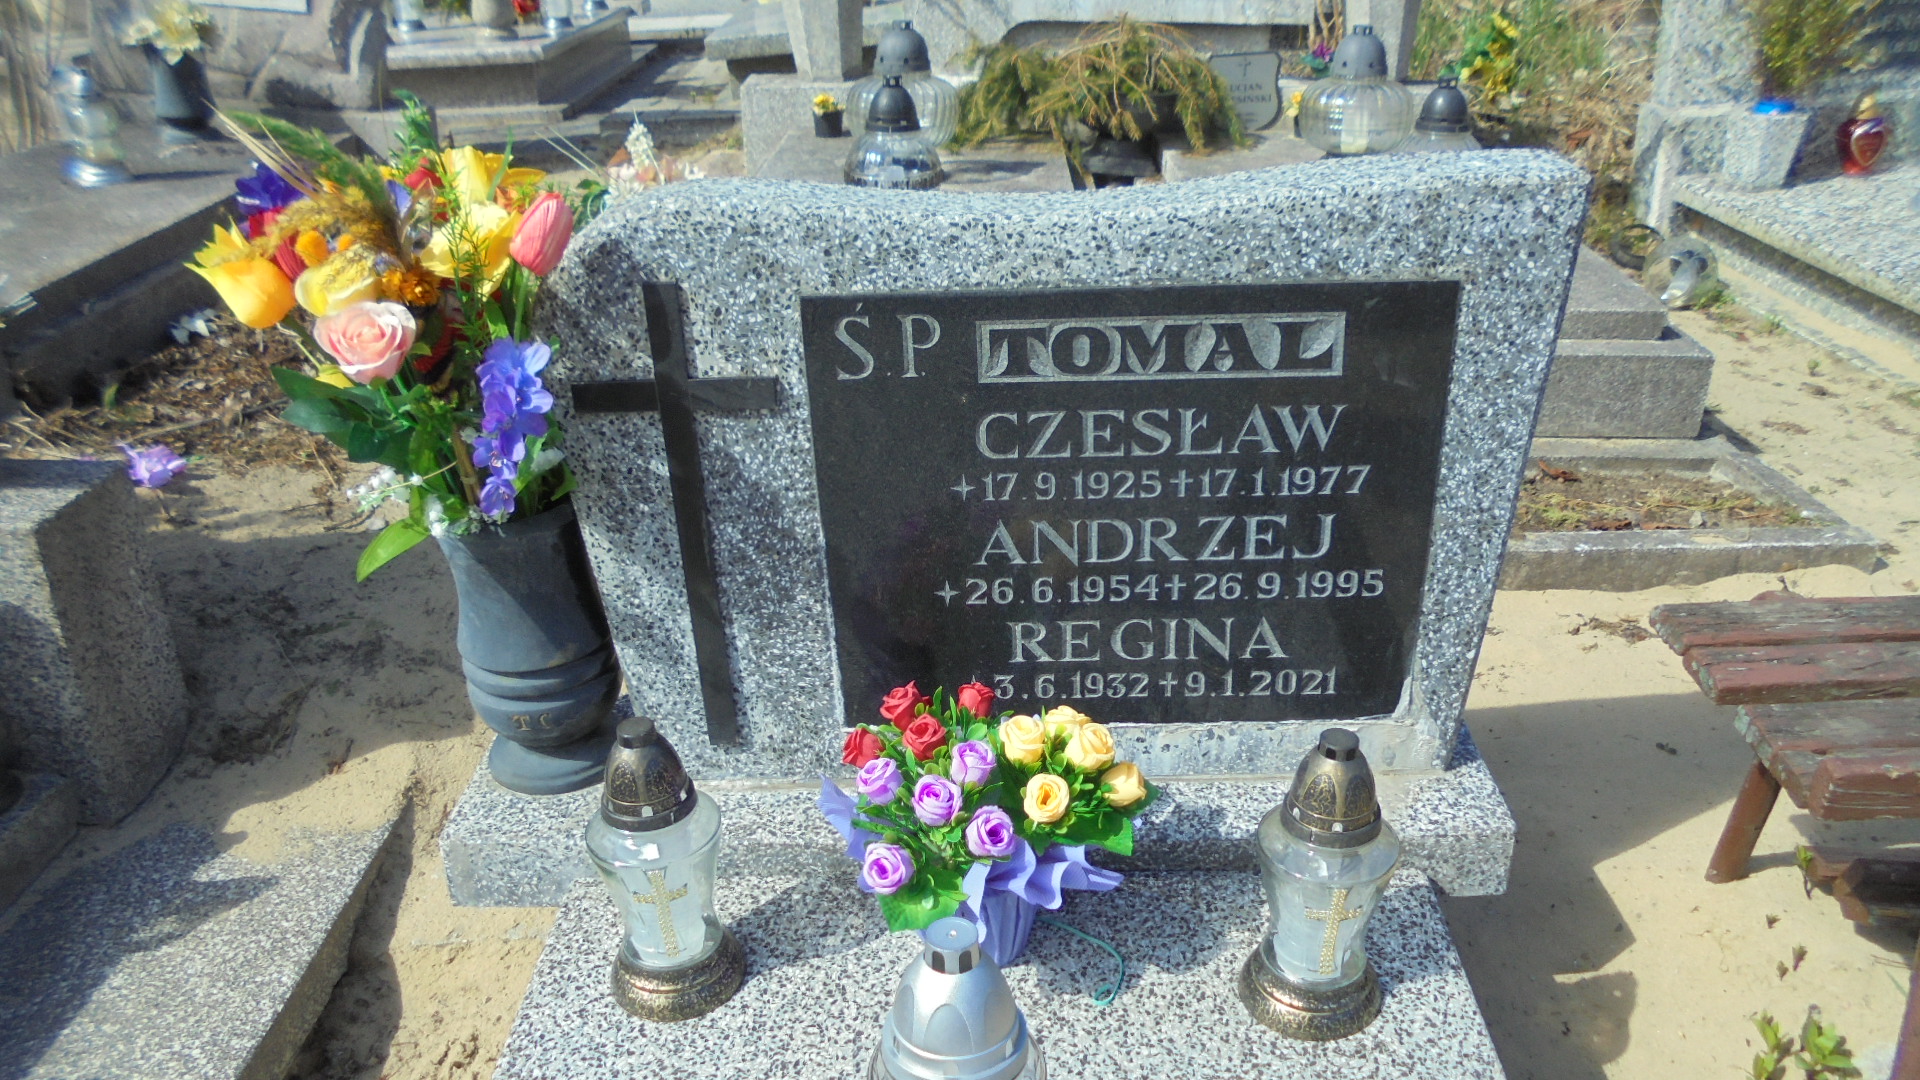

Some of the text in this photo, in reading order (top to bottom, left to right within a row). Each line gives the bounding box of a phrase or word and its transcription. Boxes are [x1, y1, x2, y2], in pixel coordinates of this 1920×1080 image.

[984, 315, 1342, 380] TOMAL
[974, 403, 1347, 460] CZESŁAW
[972, 512, 1338, 567] ANDRZEJ
[1006, 615, 1291, 665] REGINA
